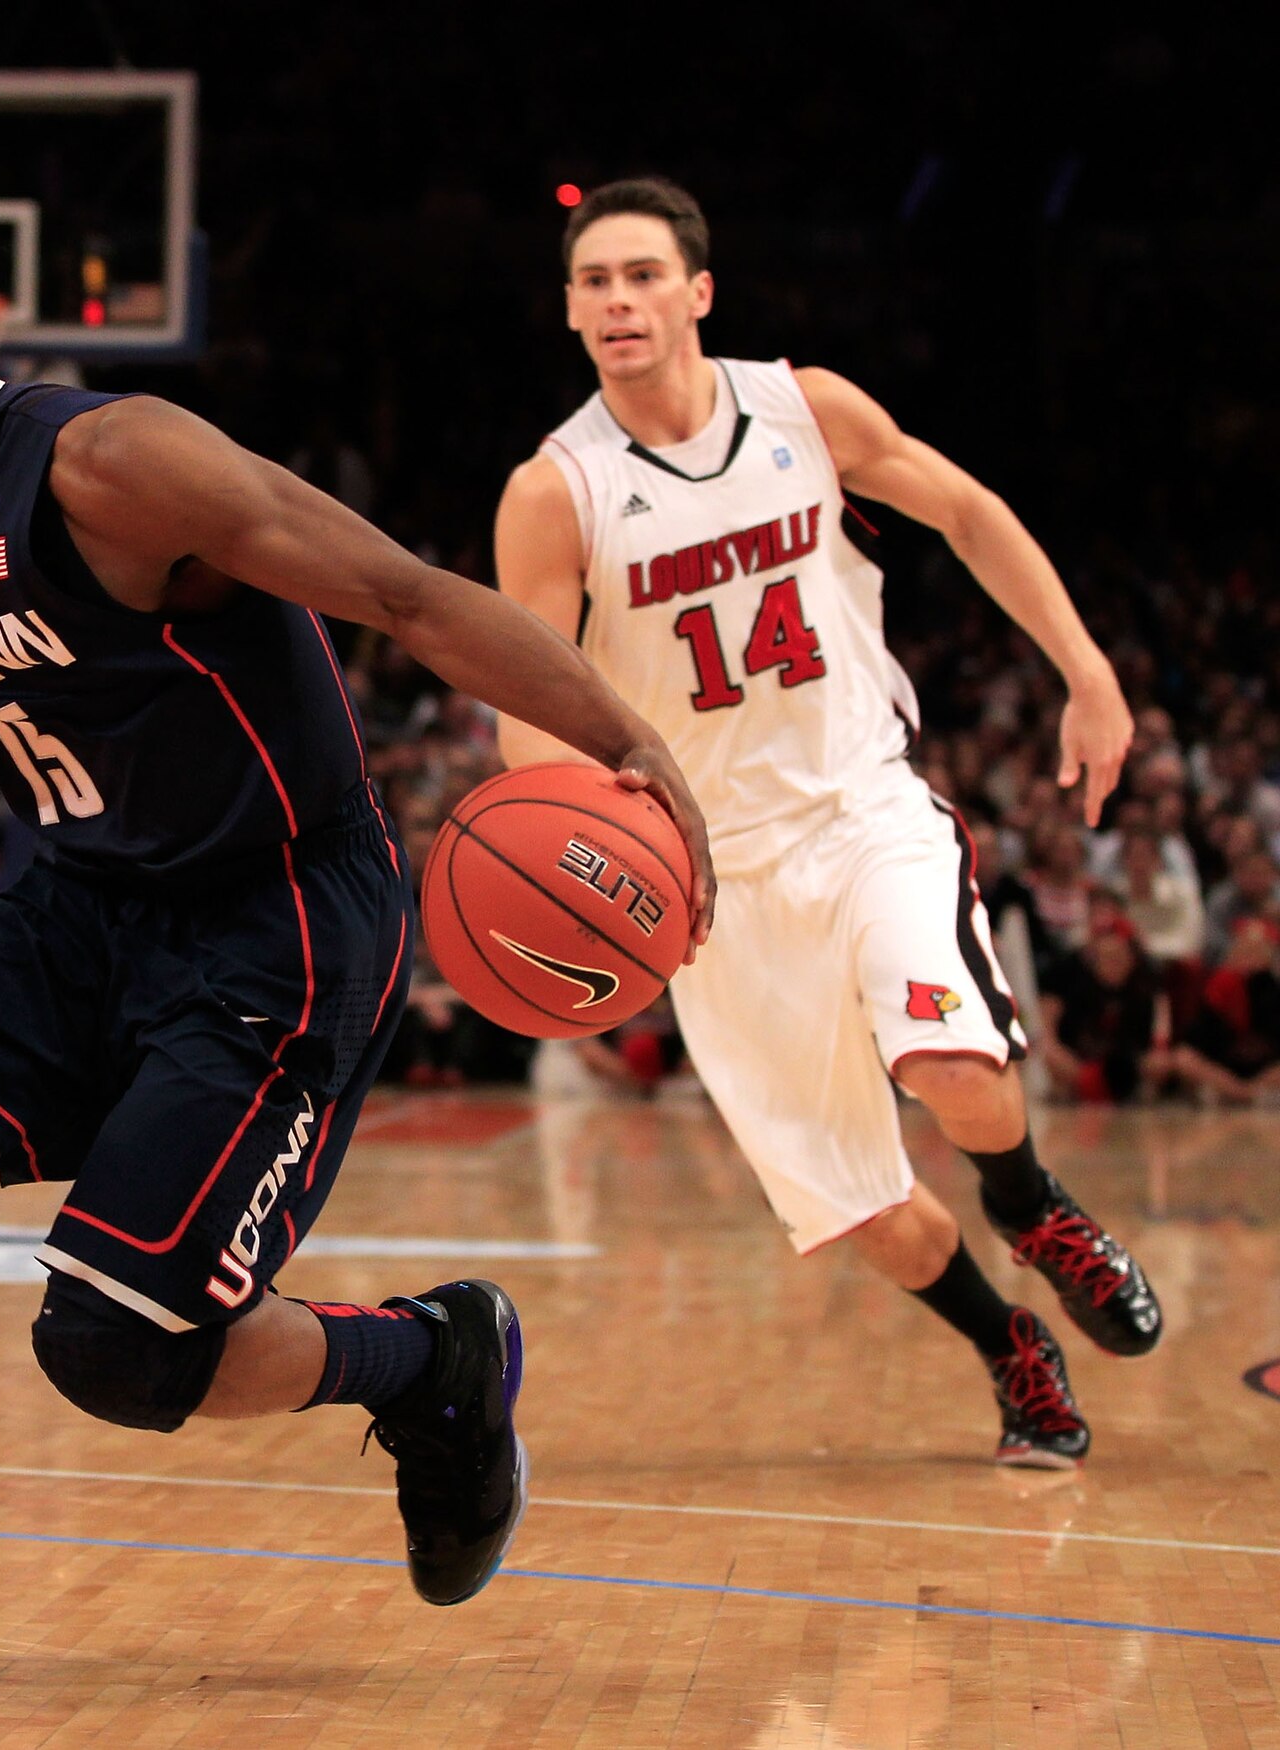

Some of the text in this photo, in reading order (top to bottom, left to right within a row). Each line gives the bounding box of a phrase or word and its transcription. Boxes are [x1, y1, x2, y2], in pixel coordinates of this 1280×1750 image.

[673, 575, 827, 712] 14
[556, 839, 665, 938] ELITE
[204, 1090, 314, 1310] UCONN
